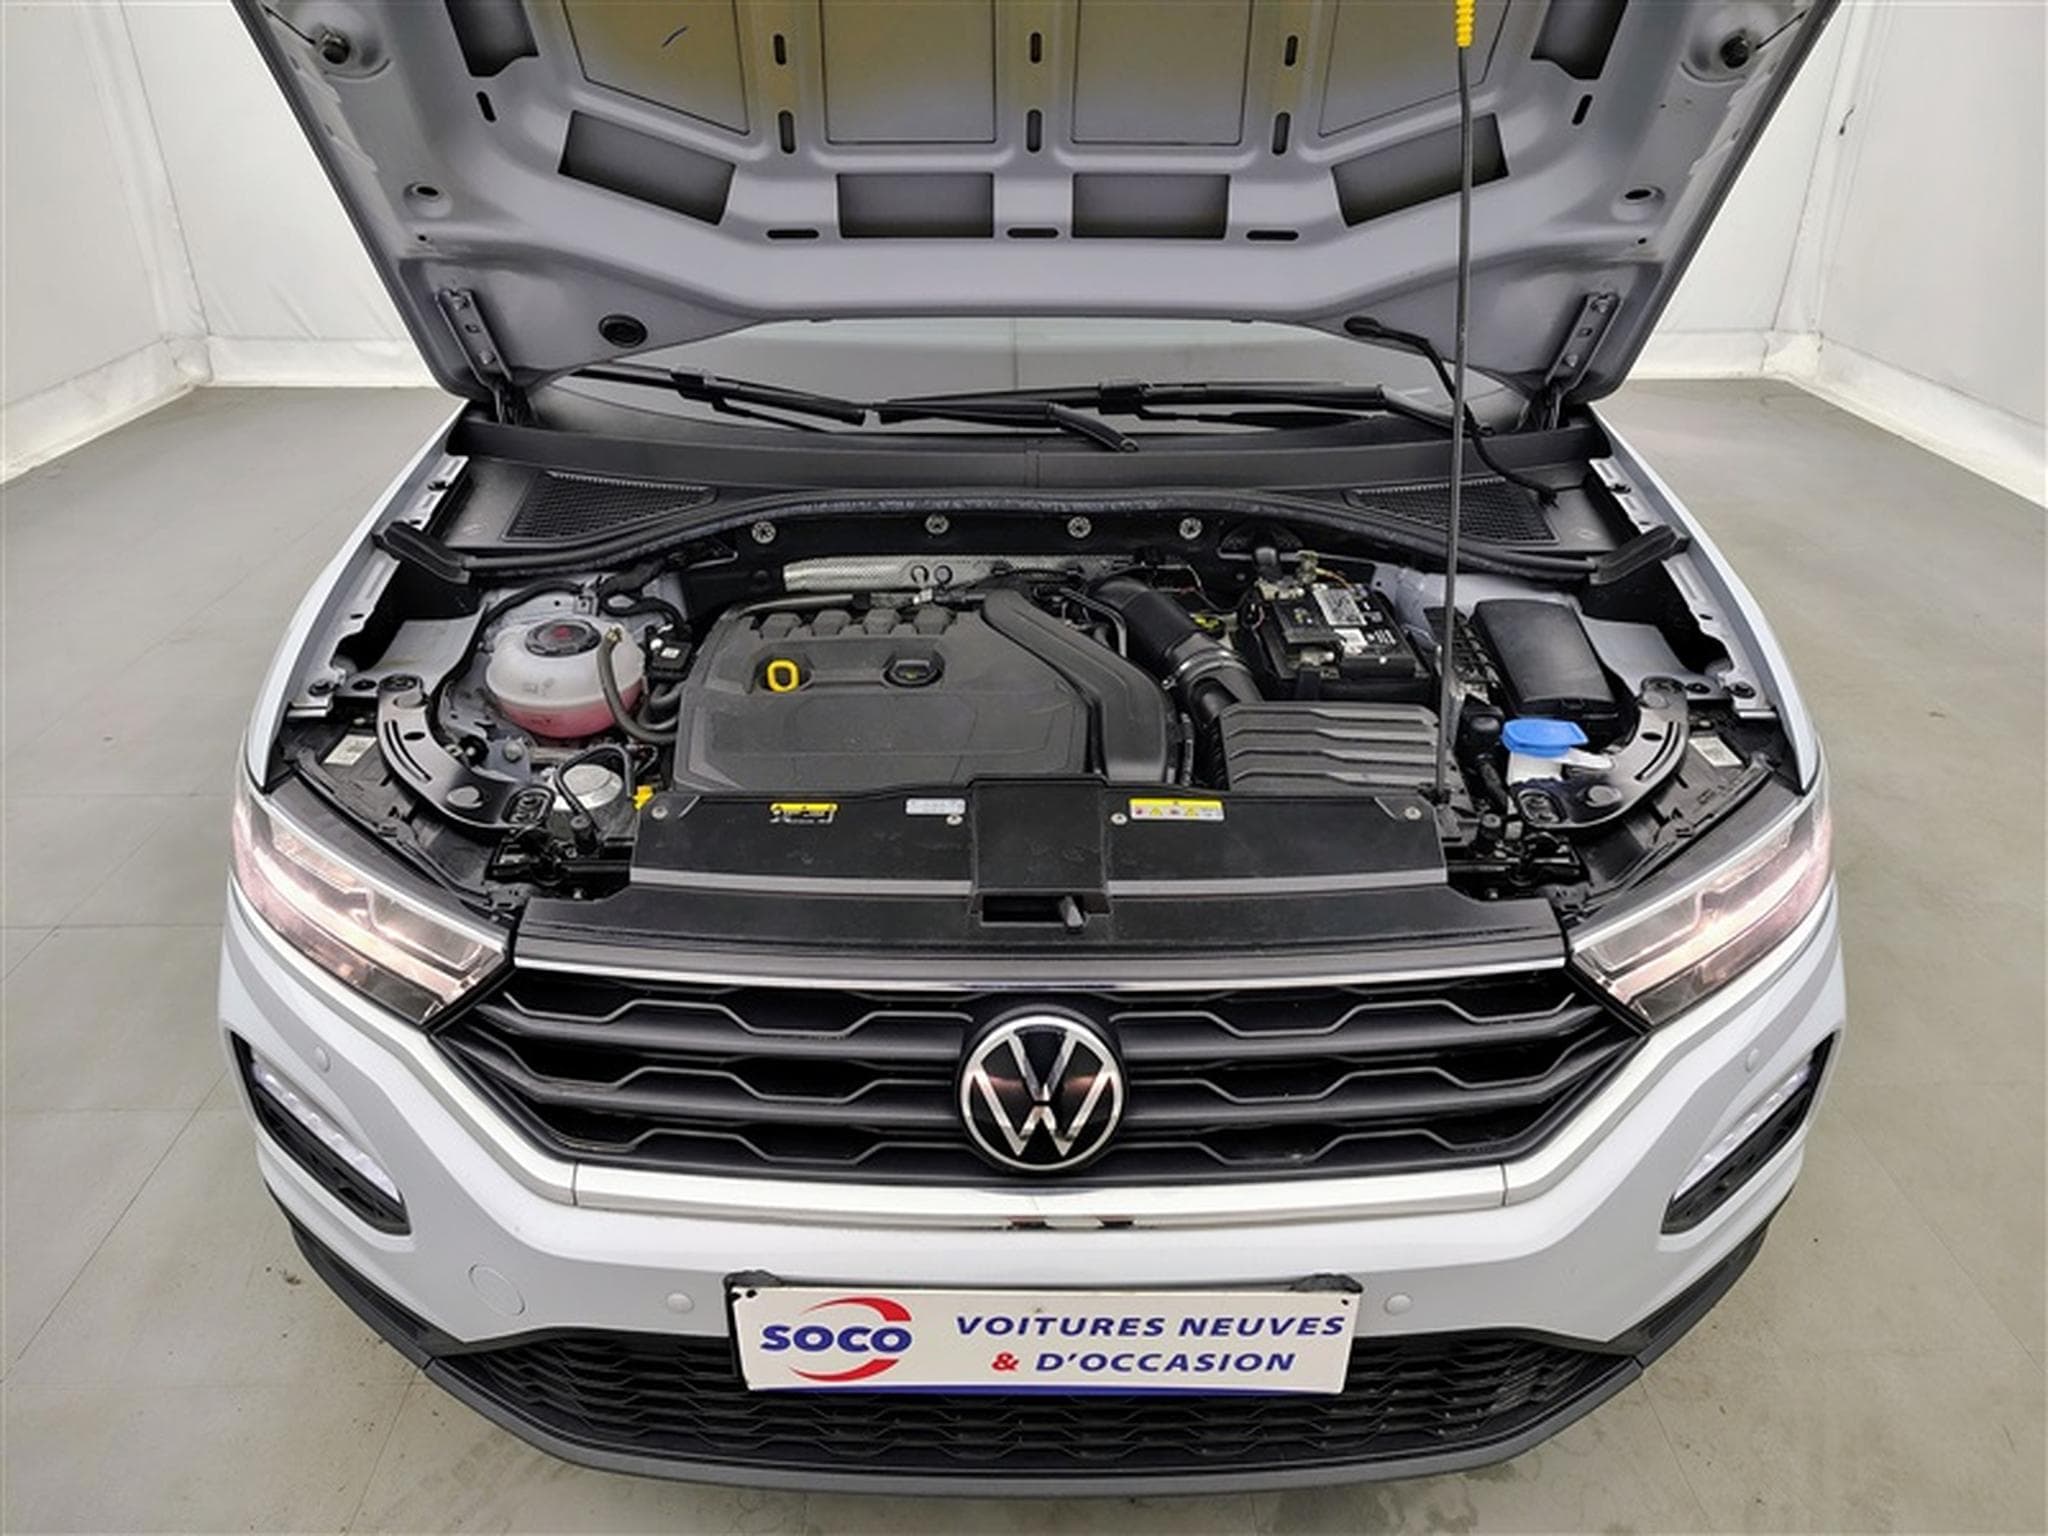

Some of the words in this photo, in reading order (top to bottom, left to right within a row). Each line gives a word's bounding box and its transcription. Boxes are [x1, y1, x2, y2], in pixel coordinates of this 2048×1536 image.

[955, 1315, 1166, 1337] VOITURES
[1177, 1316, 1345, 1337] NEUVES
[759, 1324, 913, 1354] SOCO
[991, 1351, 1020, 1372] &
[1034, 1352, 1296, 1372] D'OCCASION
